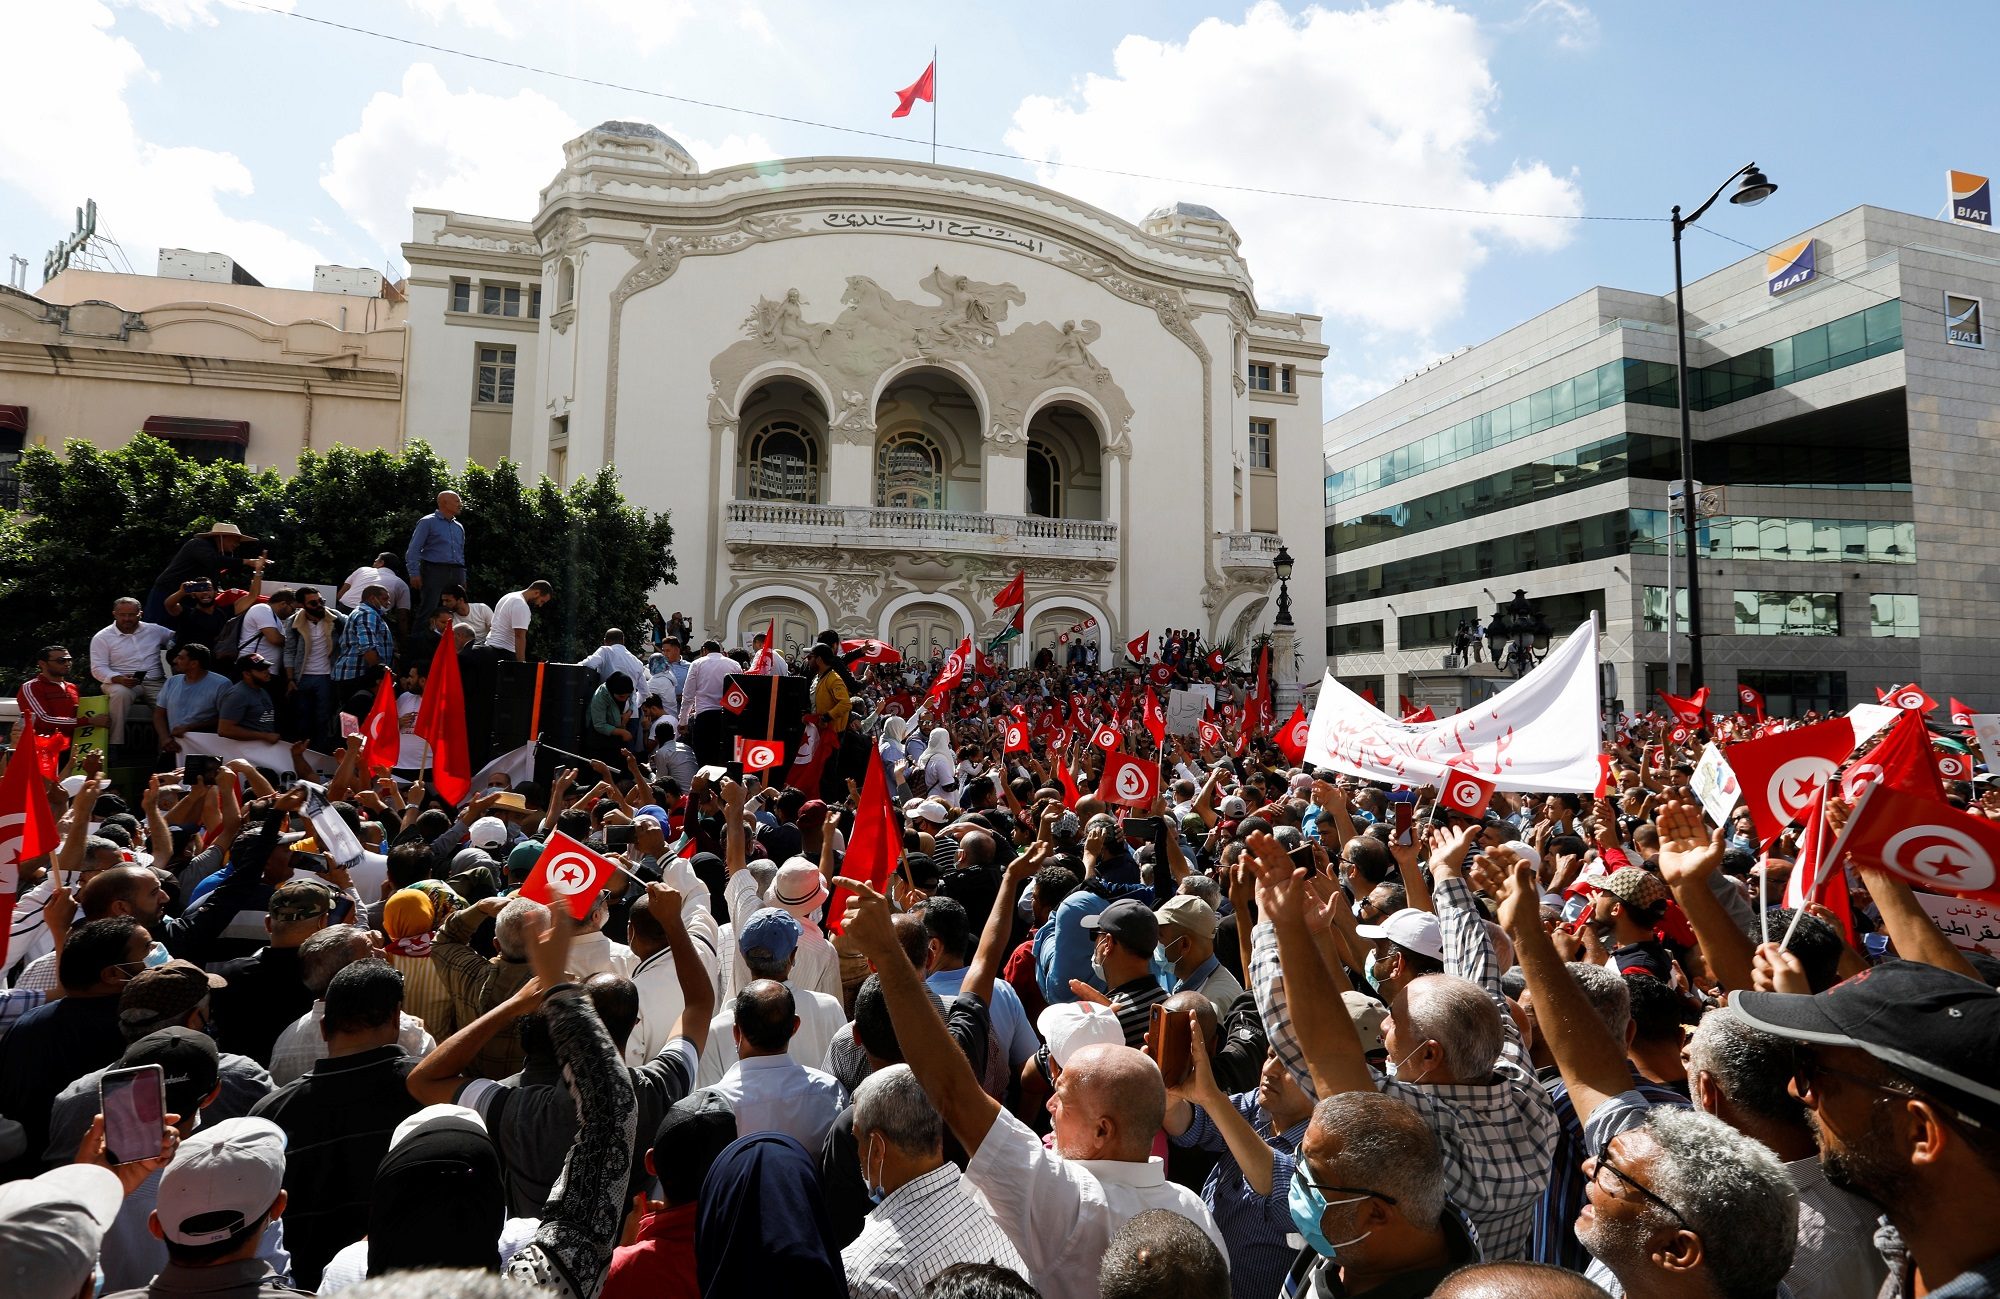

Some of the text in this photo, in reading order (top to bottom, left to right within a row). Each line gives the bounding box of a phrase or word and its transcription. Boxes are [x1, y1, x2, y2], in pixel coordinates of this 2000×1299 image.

[1957, 206, 1988, 221] BIAT
[1773, 268, 1811, 292] BIAT
[1950, 329, 1978, 342] BIAT
[1946, 904, 1988, 919] تونس
[1932, 915, 2000, 942] قراطية
